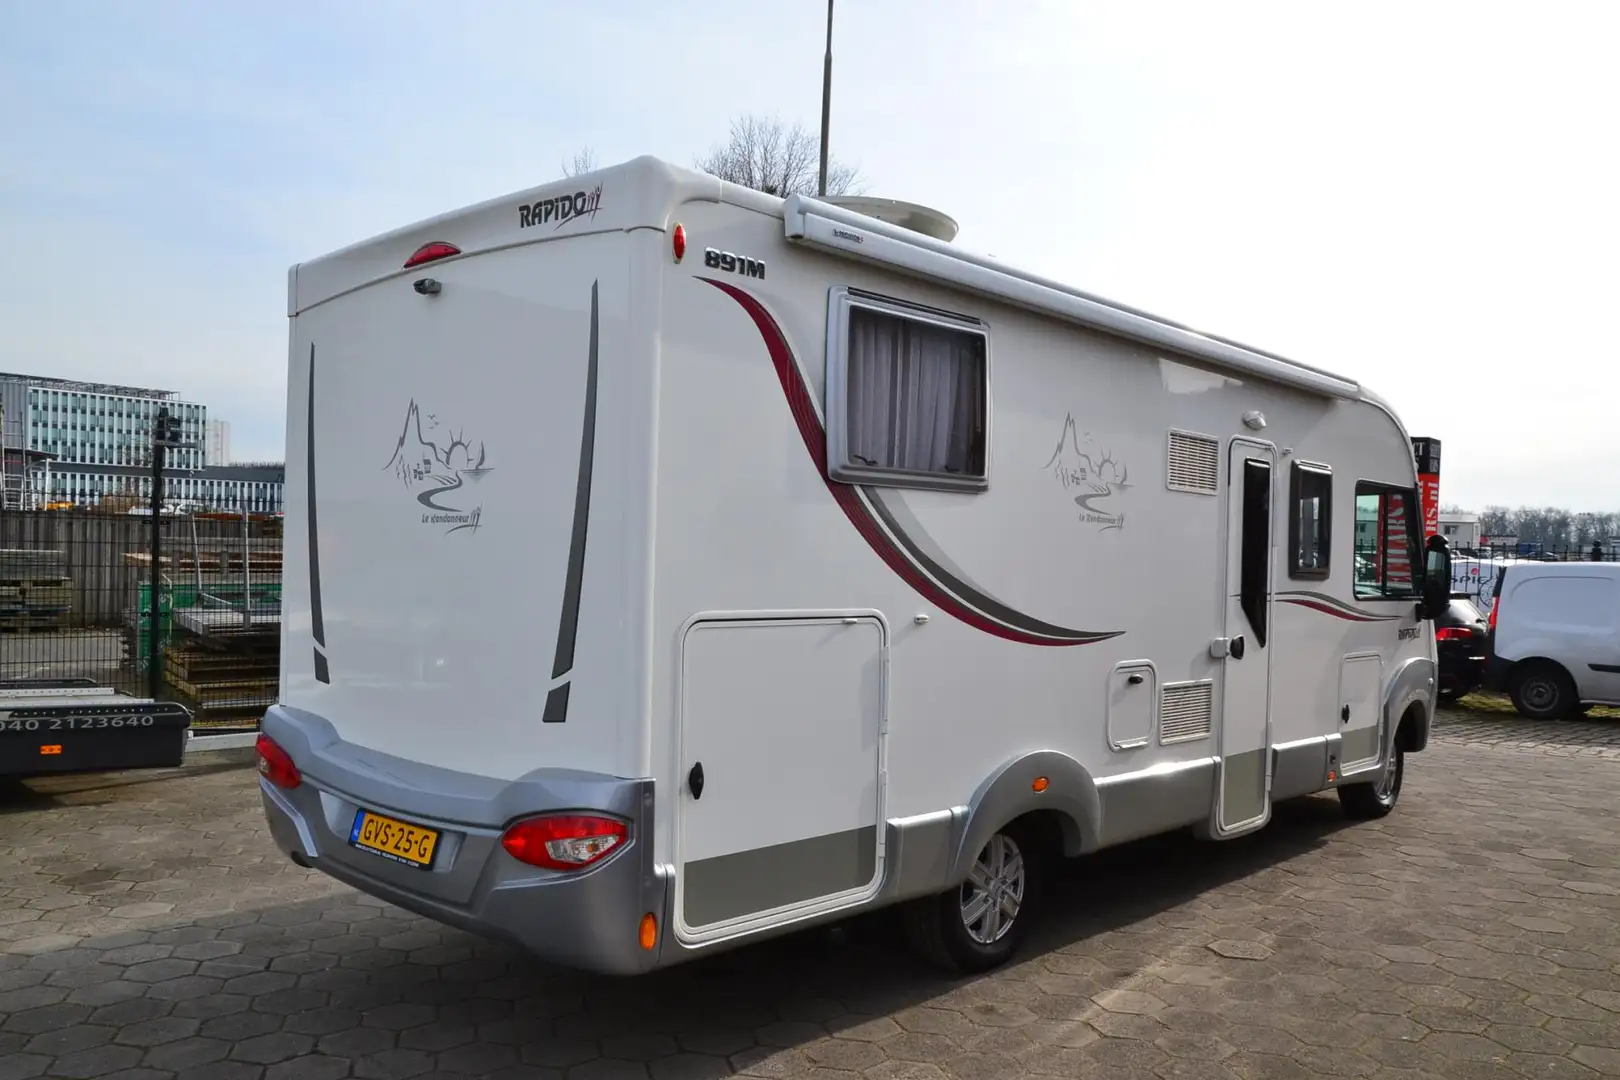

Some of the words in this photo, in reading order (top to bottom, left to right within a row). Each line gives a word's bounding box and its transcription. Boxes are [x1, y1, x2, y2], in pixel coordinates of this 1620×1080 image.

[705, 247, 766, 280] 891M
[49, 714, 154, 730] 2123640
[363, 818, 431, 859] GVS-25-G
